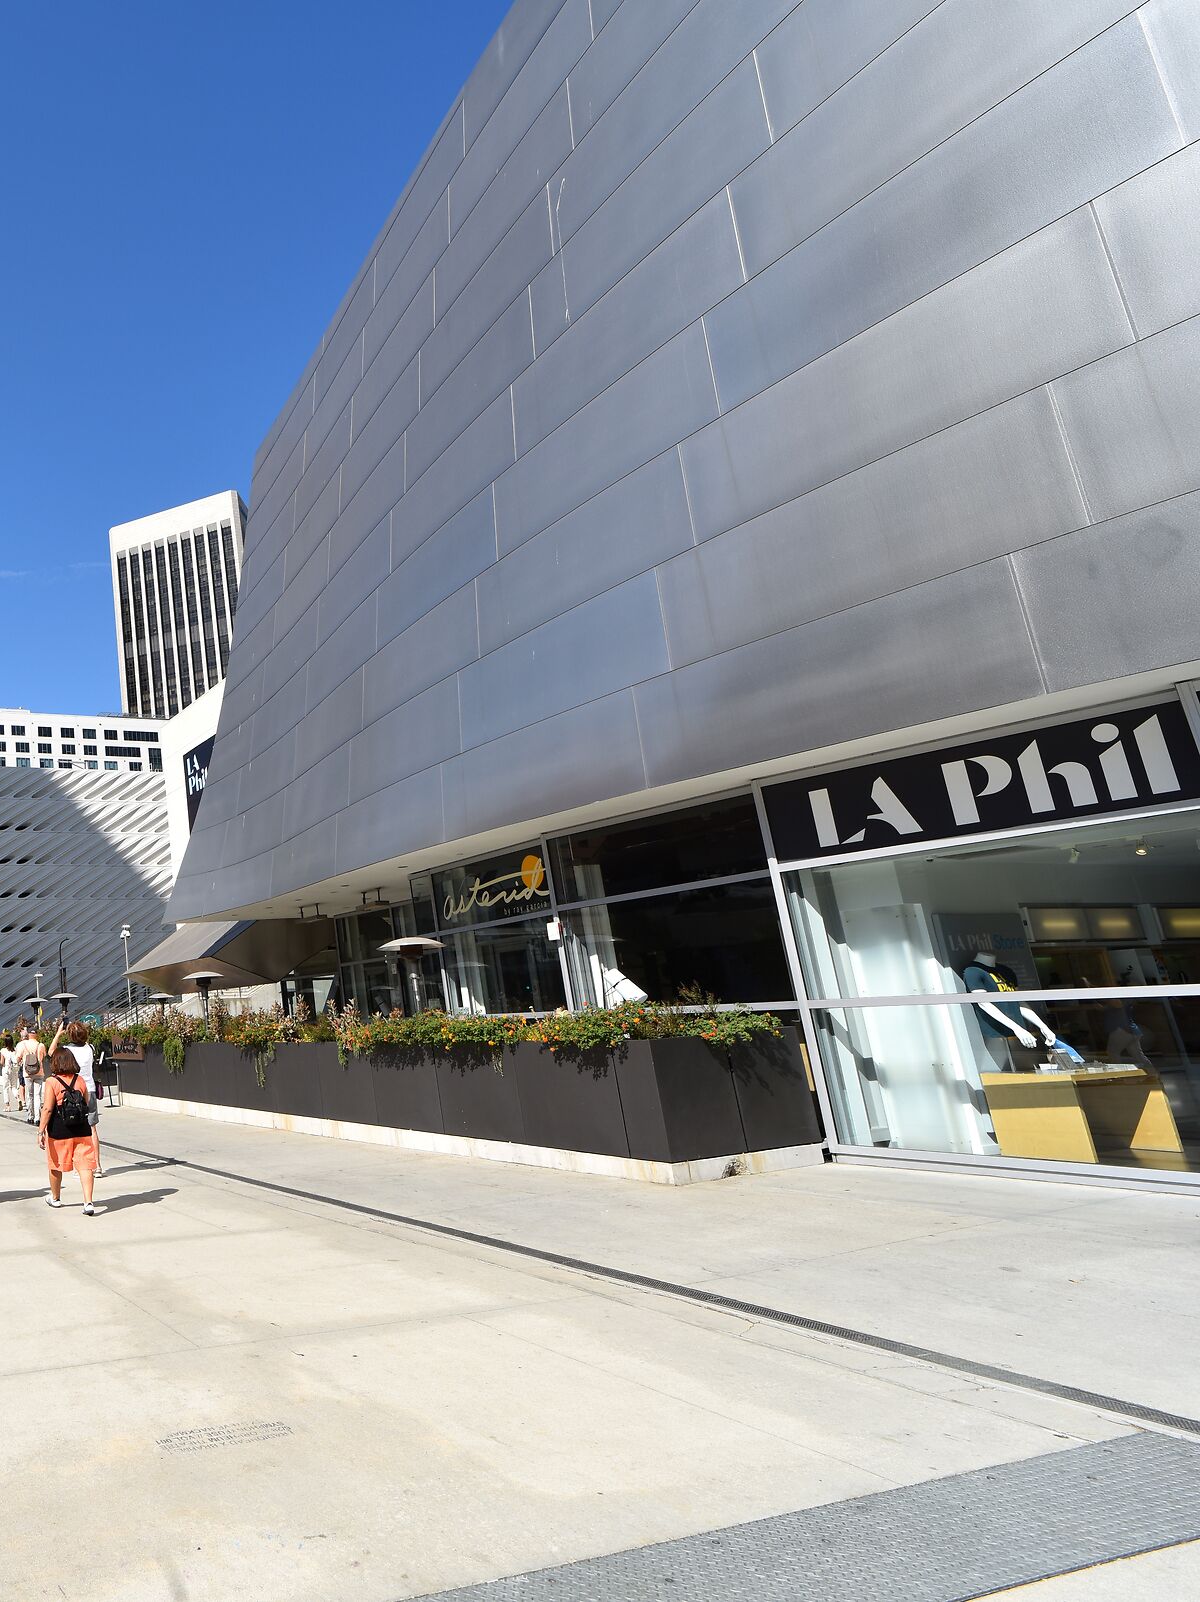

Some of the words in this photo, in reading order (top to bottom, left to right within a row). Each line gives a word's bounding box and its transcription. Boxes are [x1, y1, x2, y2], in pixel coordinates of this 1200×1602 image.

[186, 754, 200, 776] LA
[188, 766, 208, 796] Phil
[808, 776, 923, 848] LA
[941, 713, 1182, 827] Phil
[443, 857, 550, 921] asterid
[503, 908, 511, 916] by
[513, 906, 523, 915] ray
[525, 901, 548, 913] garcia
[948, 934, 966, 952] LA
[966, 932, 993, 950] Phil
[992, 933, 1025, 950] Store
